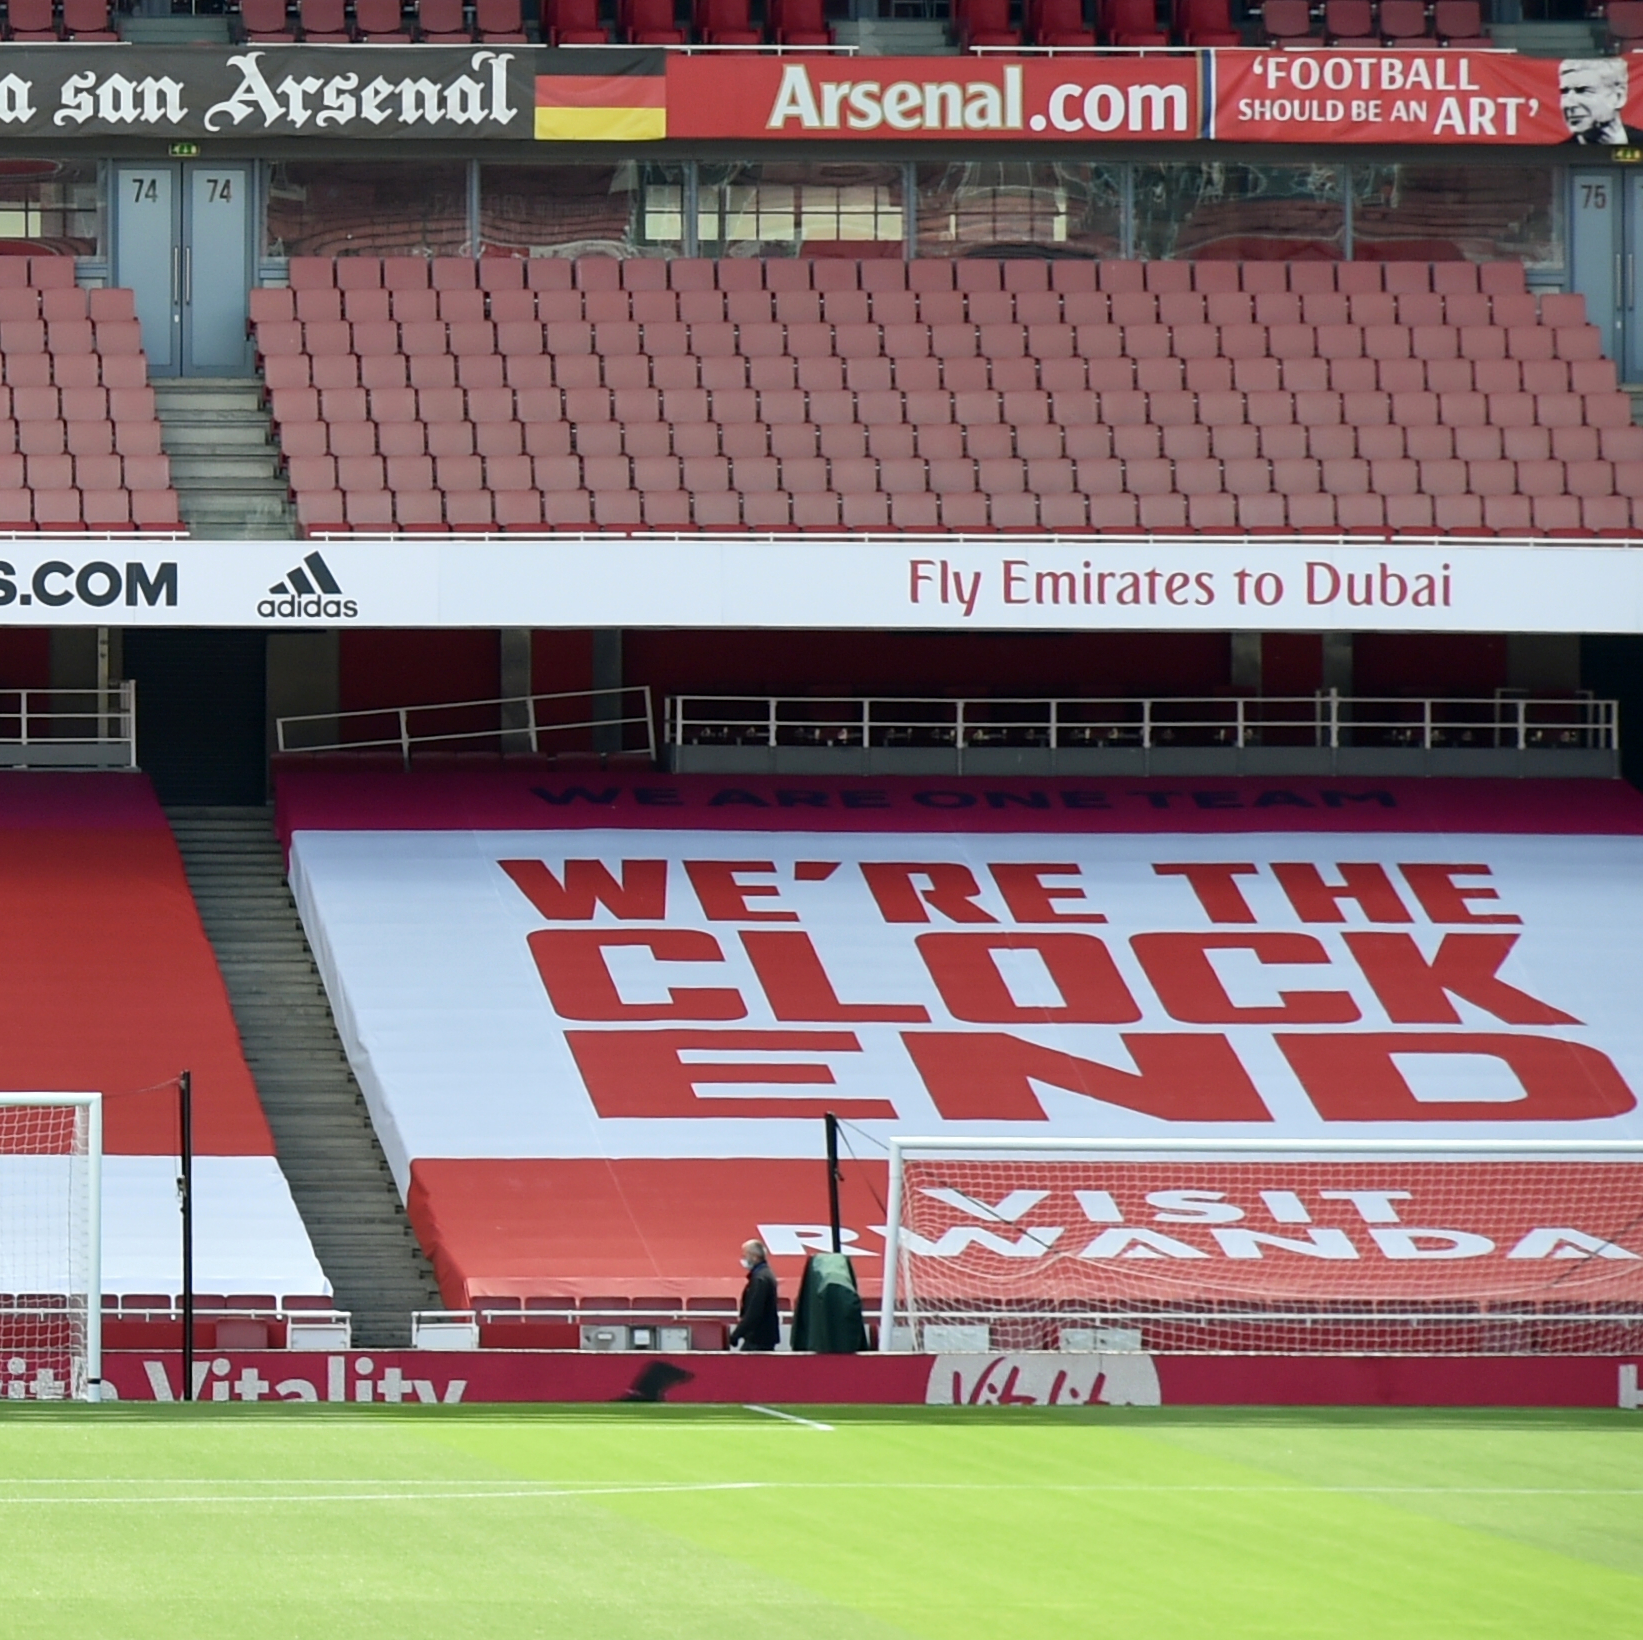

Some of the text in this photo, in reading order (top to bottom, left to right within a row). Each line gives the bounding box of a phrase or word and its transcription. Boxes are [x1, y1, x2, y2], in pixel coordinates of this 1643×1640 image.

[53, 72, 189, 126] san
[203, 51, 519, 133] Arsenal
[766, 64, 1189, 132] Arsenal.com
[1238, 99, 1345, 122] SHOULD
[1351, 100, 1383, 122] BE
[1390, 101, 1427, 123] AN
[132, 179, 158, 203] 74
[206, 179, 233, 203] 74
[1581, 184, 1607, 209] 75
[908, 560, 1453, 617] Fly Emirates to Dubai
[256, 594, 359, 619] adidas
[528, 785, 1401, 811] WE ARE ONE TEAM
[1153, 863, 1523, 925] THE
[526, 928, 1587, 1027] CLOCK
[563, 1029, 1638, 1123] END
[919, 1189, 1414, 1224] VISIT
[756, 1224, 1642, 1259] RWANDA
